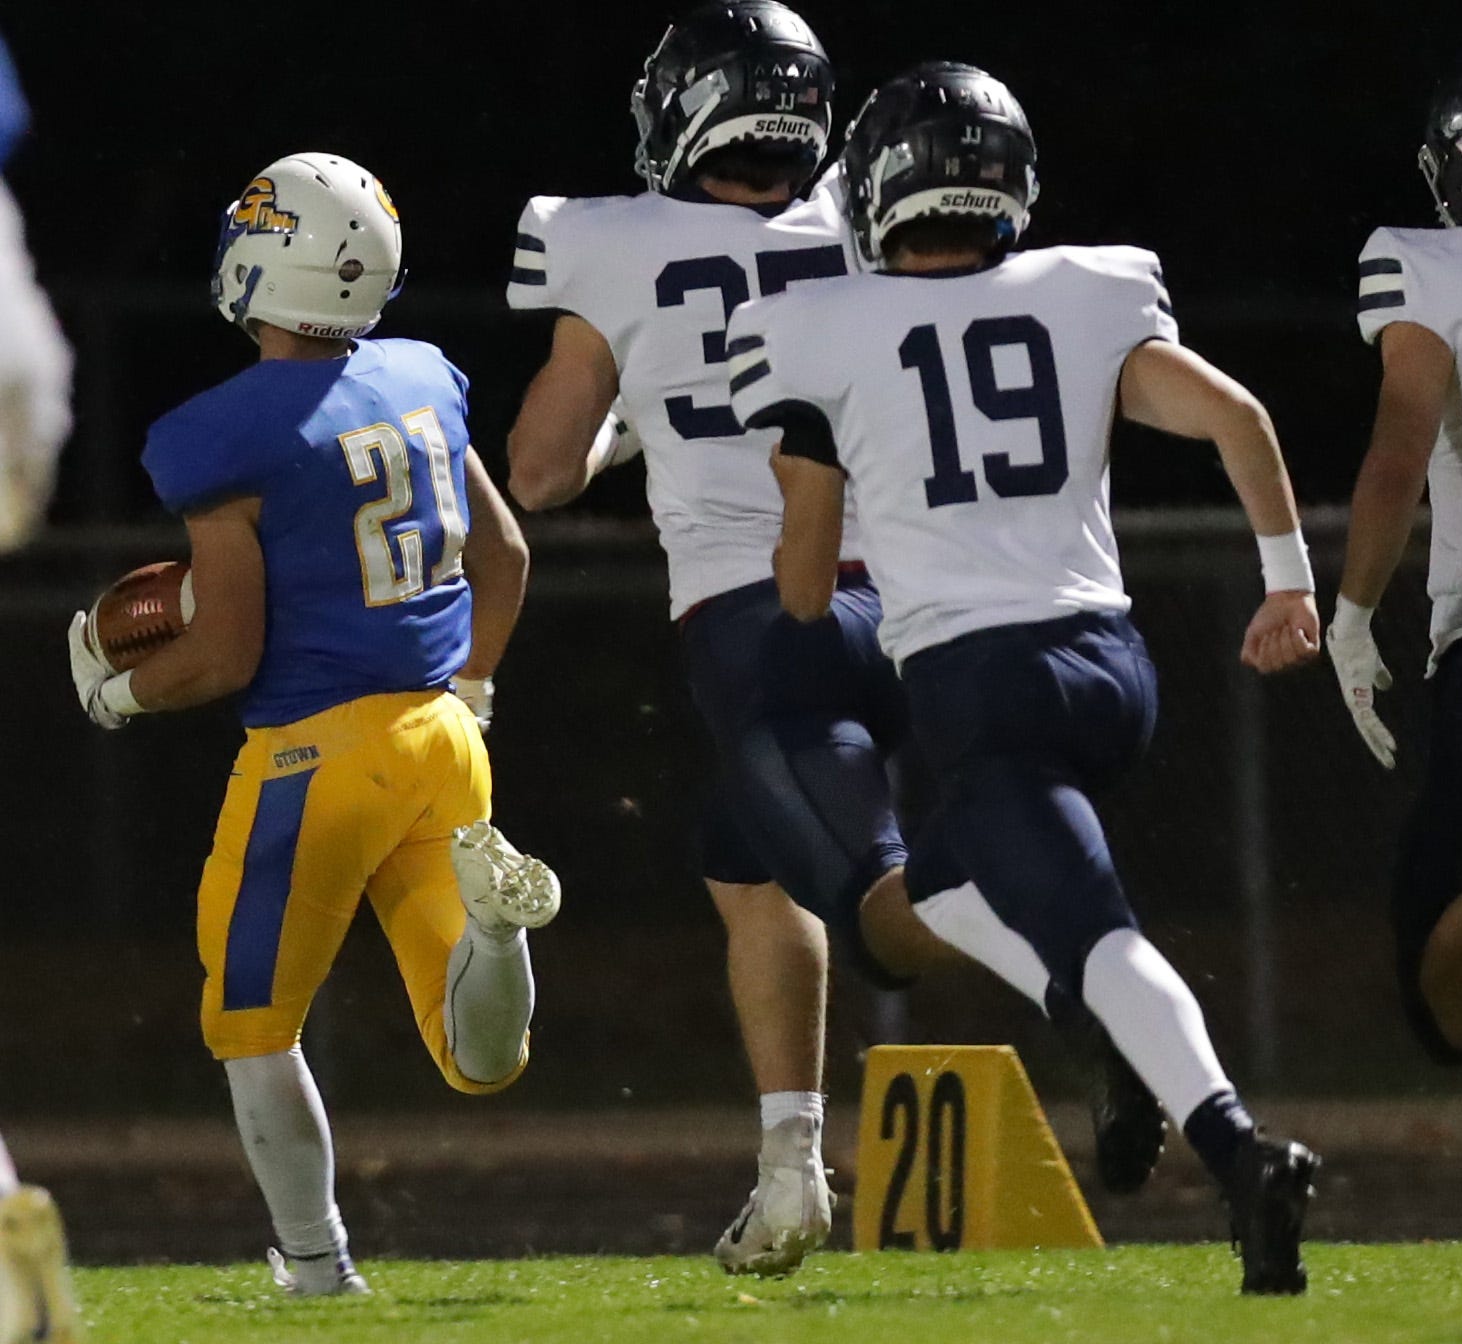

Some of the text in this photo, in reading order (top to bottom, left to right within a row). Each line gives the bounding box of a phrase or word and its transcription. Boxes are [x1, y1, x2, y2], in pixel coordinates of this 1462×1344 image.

[775, 93, 795, 110] JJ
[754, 116, 810, 136] schutt
[961, 125, 981, 144] JJ
[941, 190, 1001, 209] schutt
[899, 315, 1069, 508] 19
[337, 406, 466, 608] 21
[273, 745, 320, 768] GTOWN
[879, 1070, 966, 1254] 20
